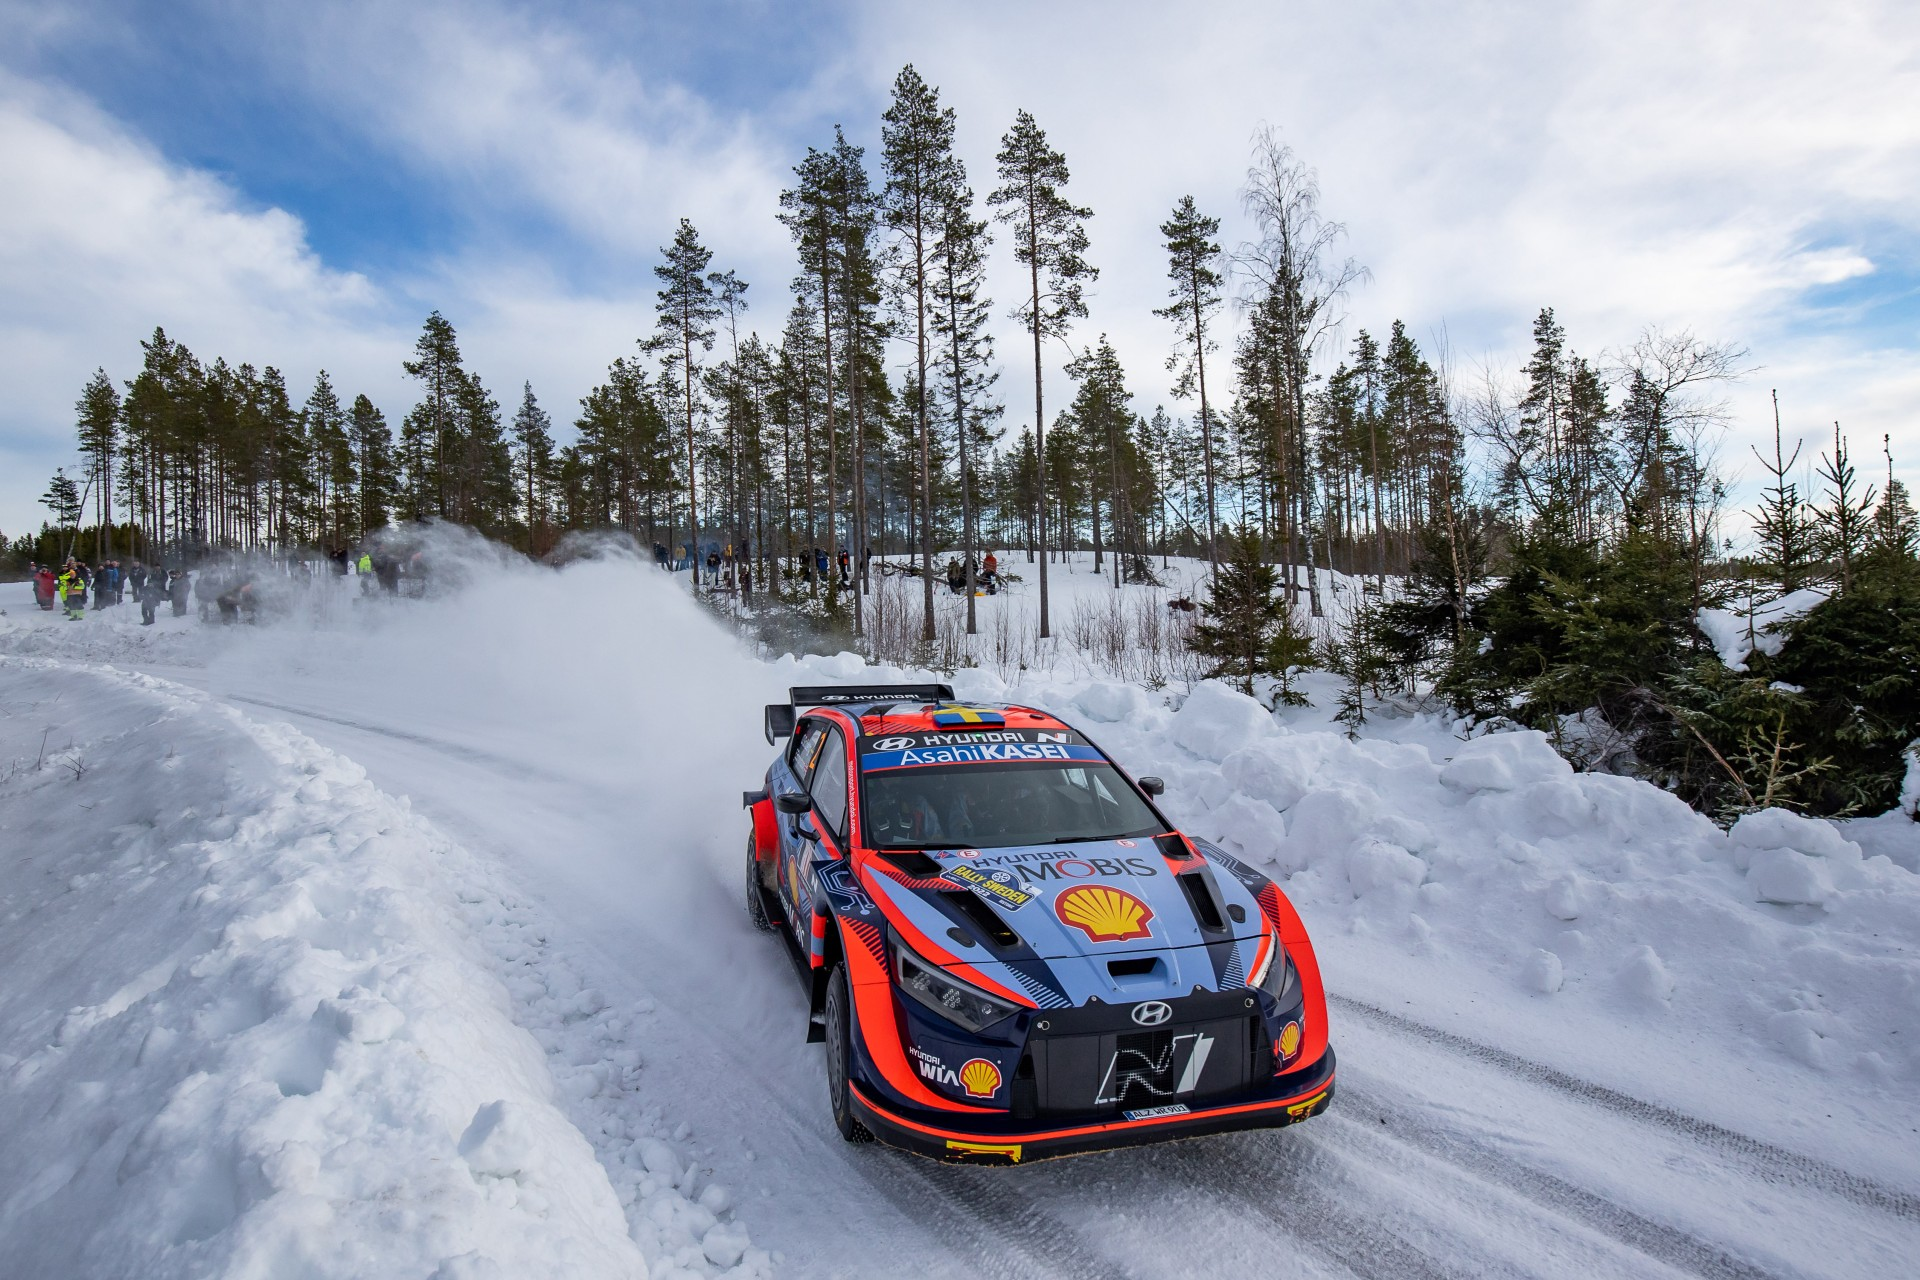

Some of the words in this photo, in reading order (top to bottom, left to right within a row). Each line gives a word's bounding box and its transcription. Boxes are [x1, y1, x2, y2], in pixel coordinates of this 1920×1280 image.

[923, 732, 1026, 746] HYUNDAI
[972, 850, 1077, 869] HYUNDAI
[1010, 857, 1158, 883] MOBIS
[952, 865, 987, 884] RALLY
[981, 879, 1030, 904] SWEDEN
[909, 1046, 940, 1065] HYUNDAI
